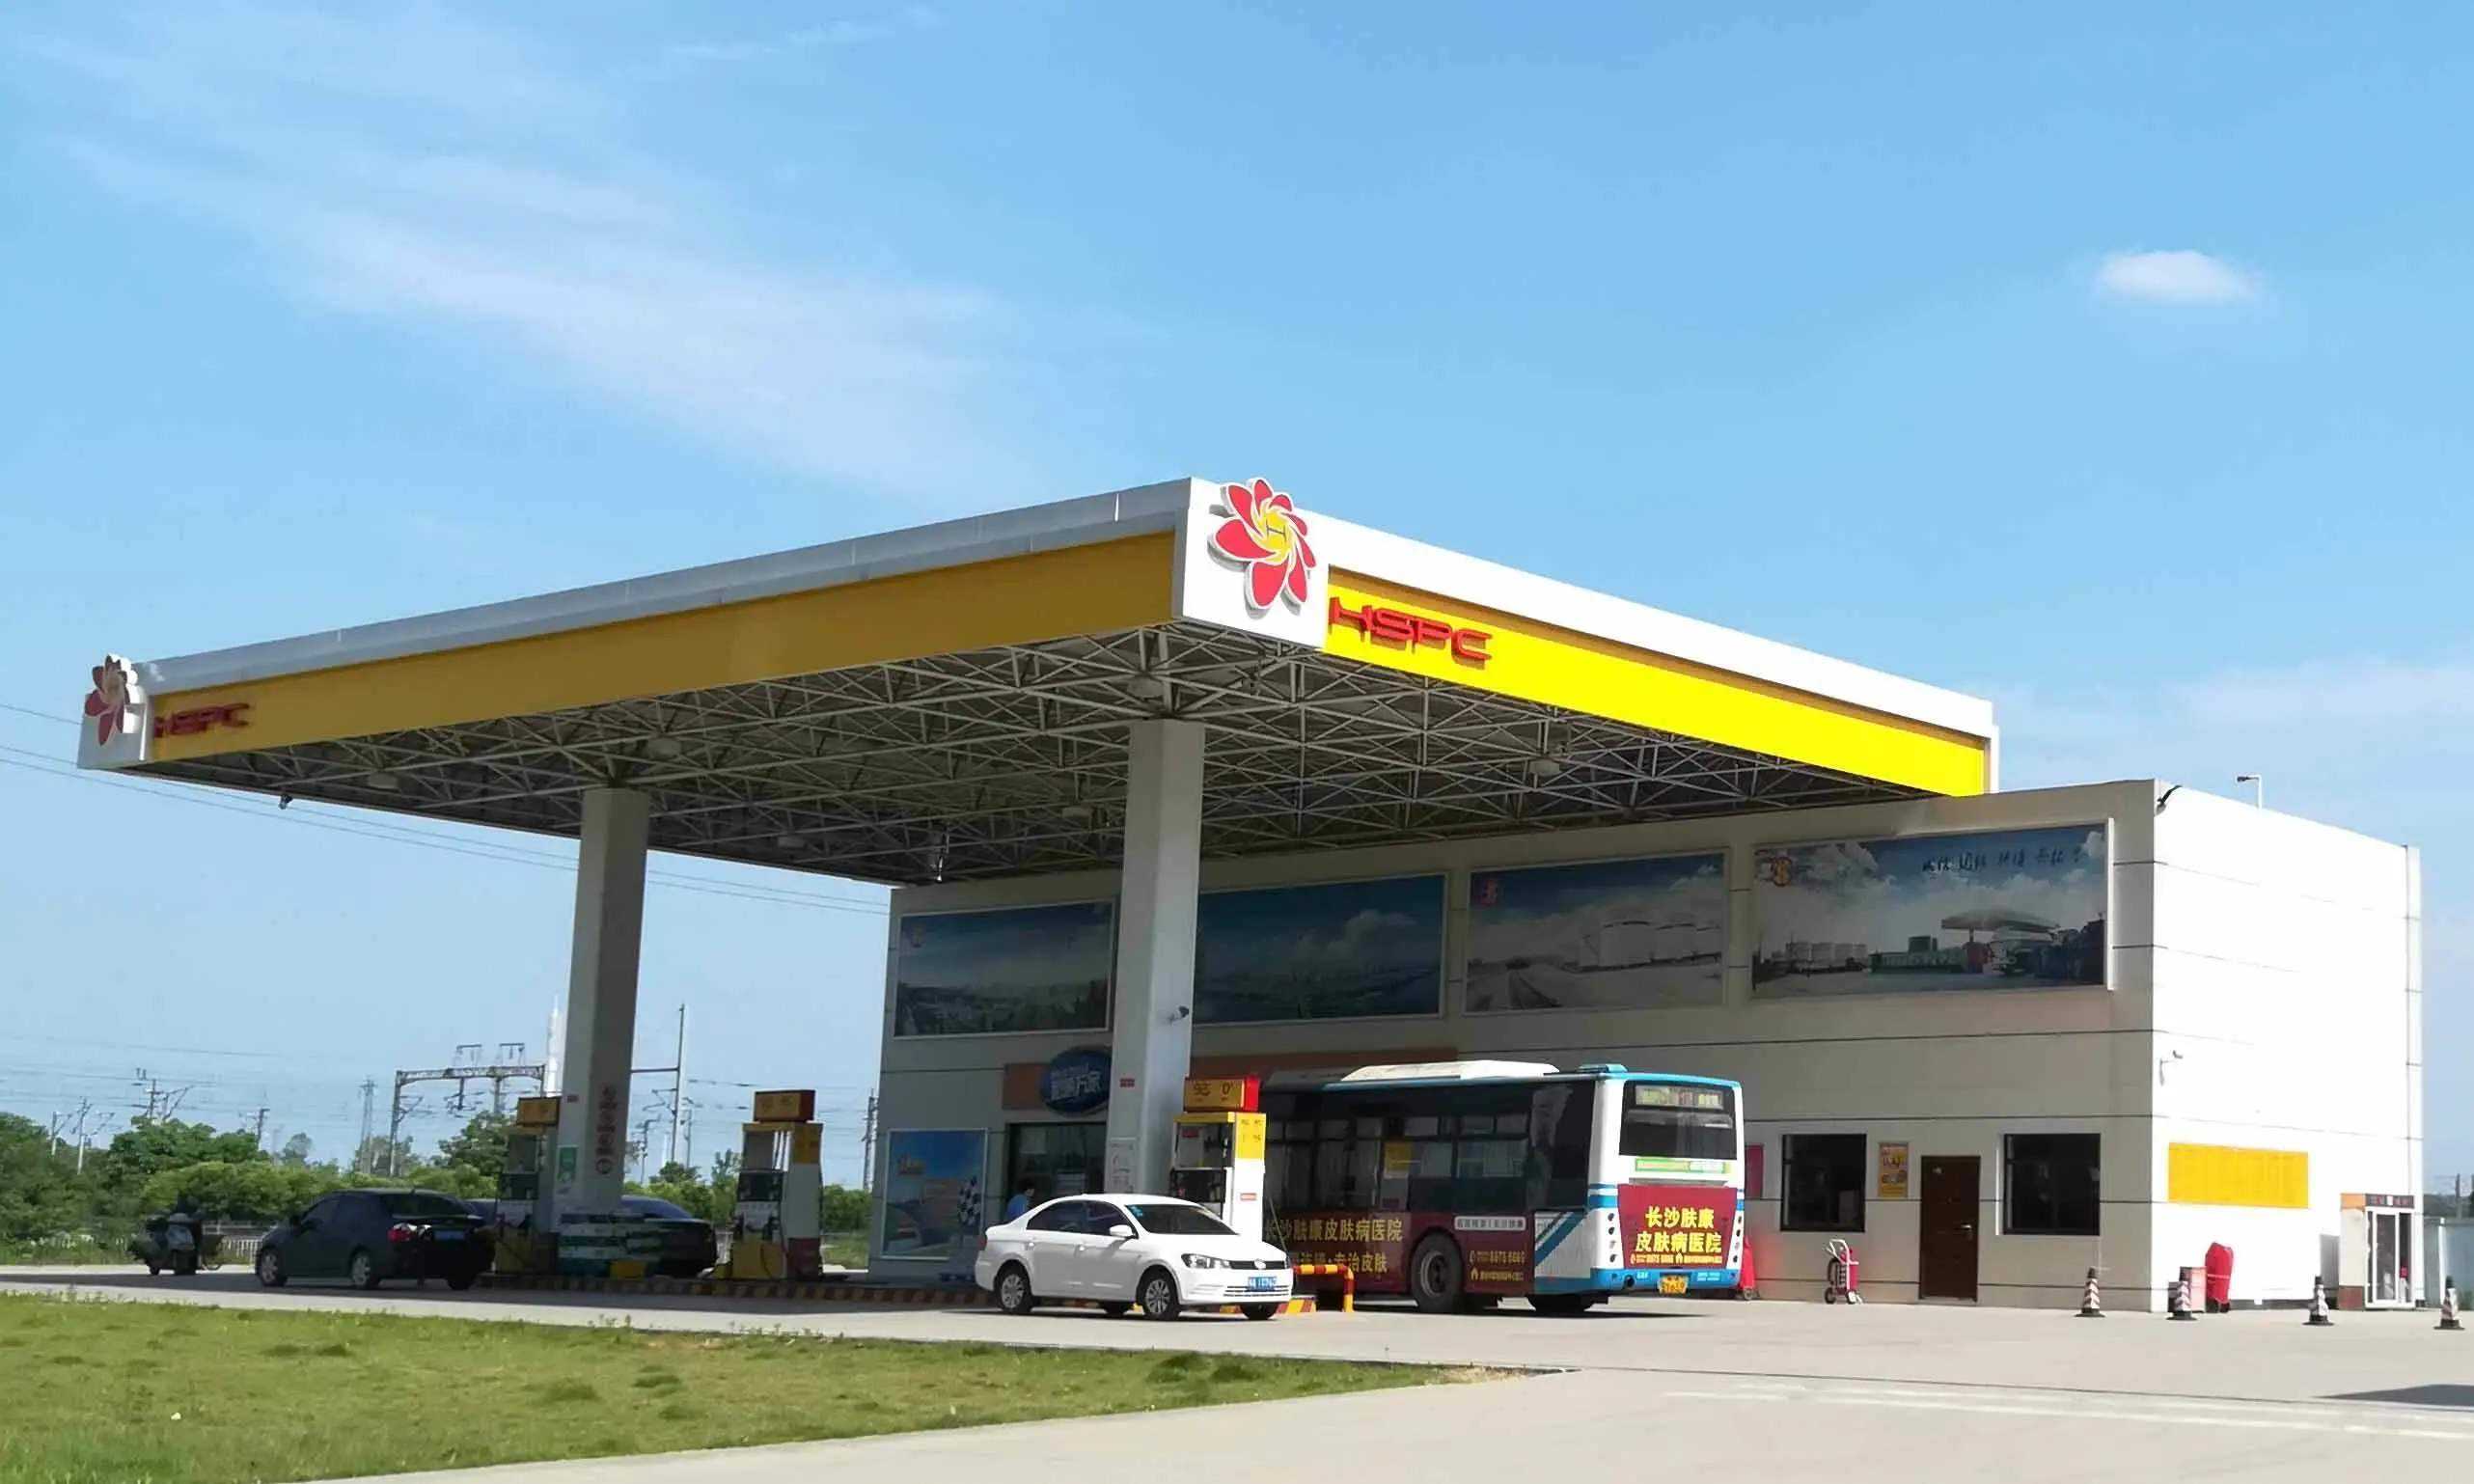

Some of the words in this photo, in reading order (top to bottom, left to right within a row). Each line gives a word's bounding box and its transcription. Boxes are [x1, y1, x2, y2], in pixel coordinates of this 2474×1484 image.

[1329, 596, 1493, 664] HSPC
[1645, 1205, 1715, 1228] 长沙肤康
[1635, 1231, 1722, 1253] 皮肤病医院
